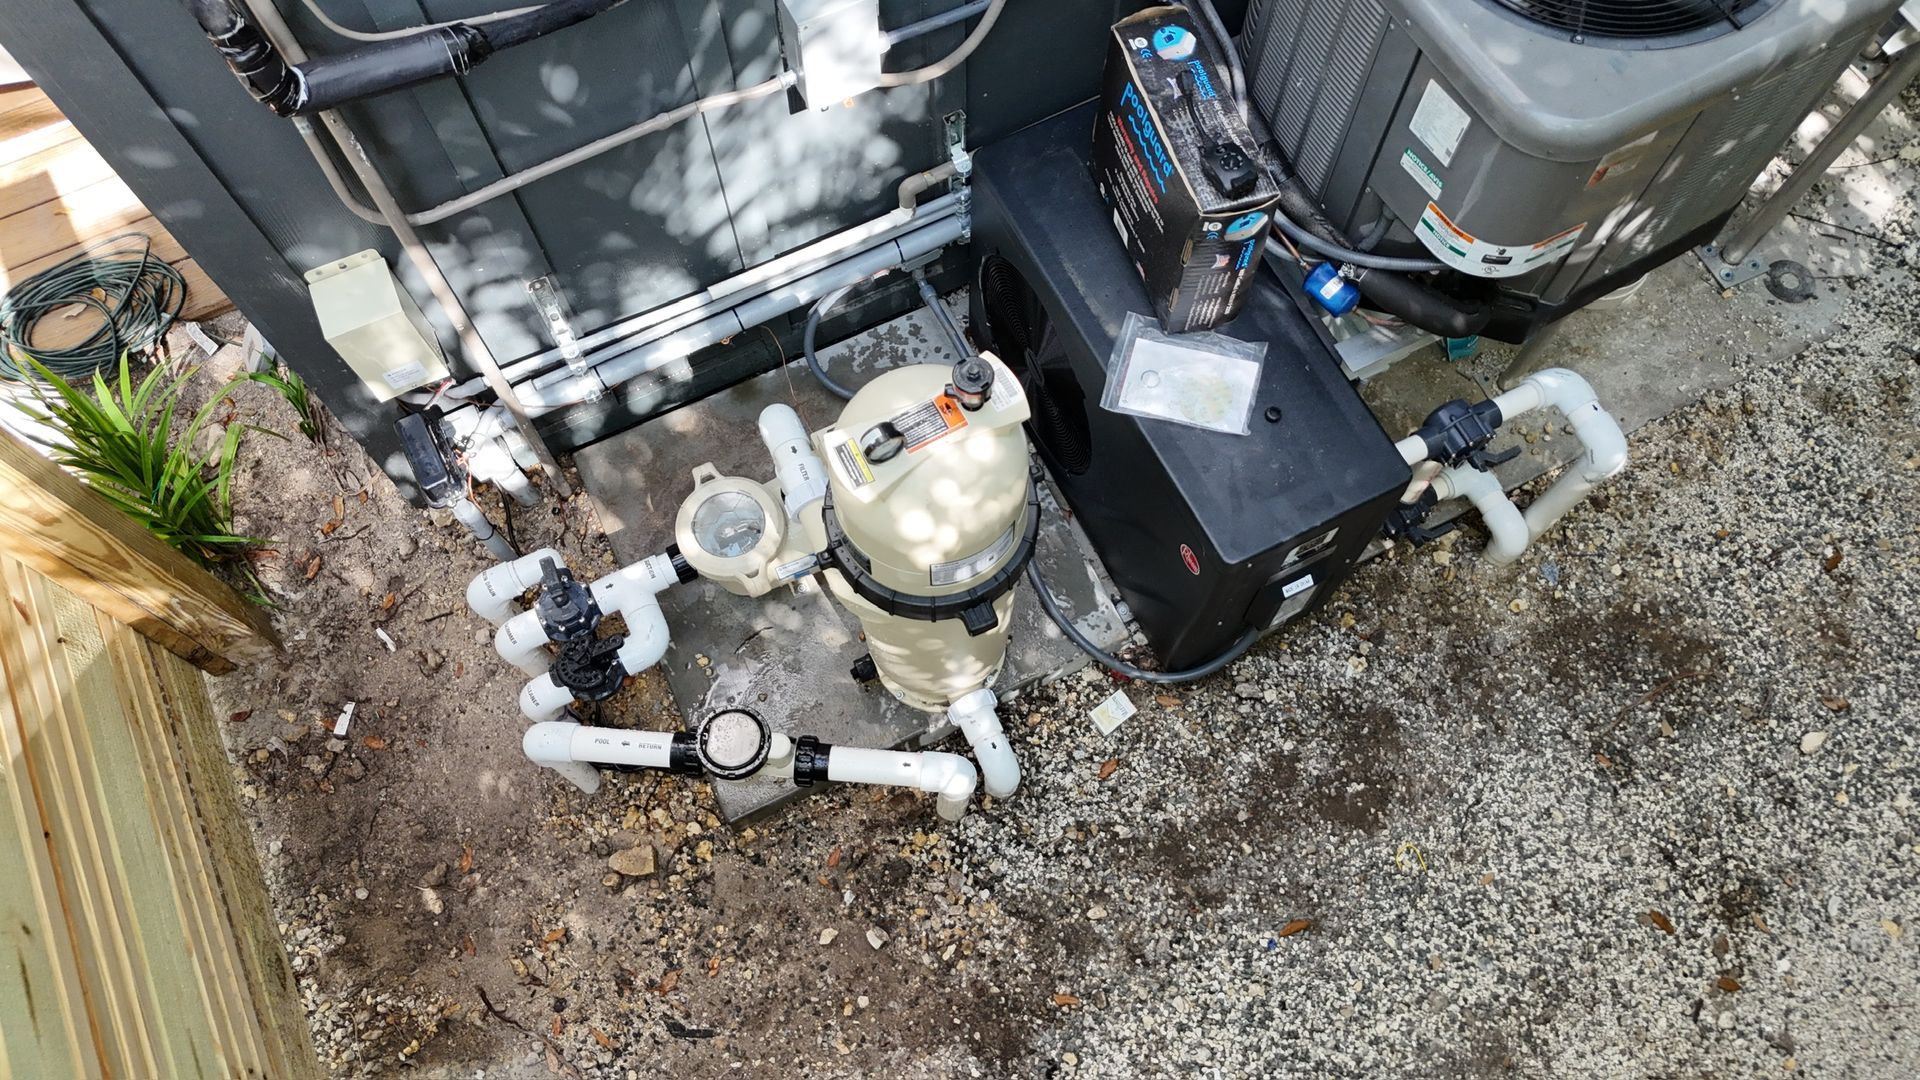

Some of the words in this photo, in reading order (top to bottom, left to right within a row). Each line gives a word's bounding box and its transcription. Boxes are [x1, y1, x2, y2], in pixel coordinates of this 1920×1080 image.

[1187, 60, 1215, 98] poolguard
[1120, 81, 1173, 178] poolguard
[798, 463, 810, 482] FILTER
[638, 742, 662, 751] RETURN
